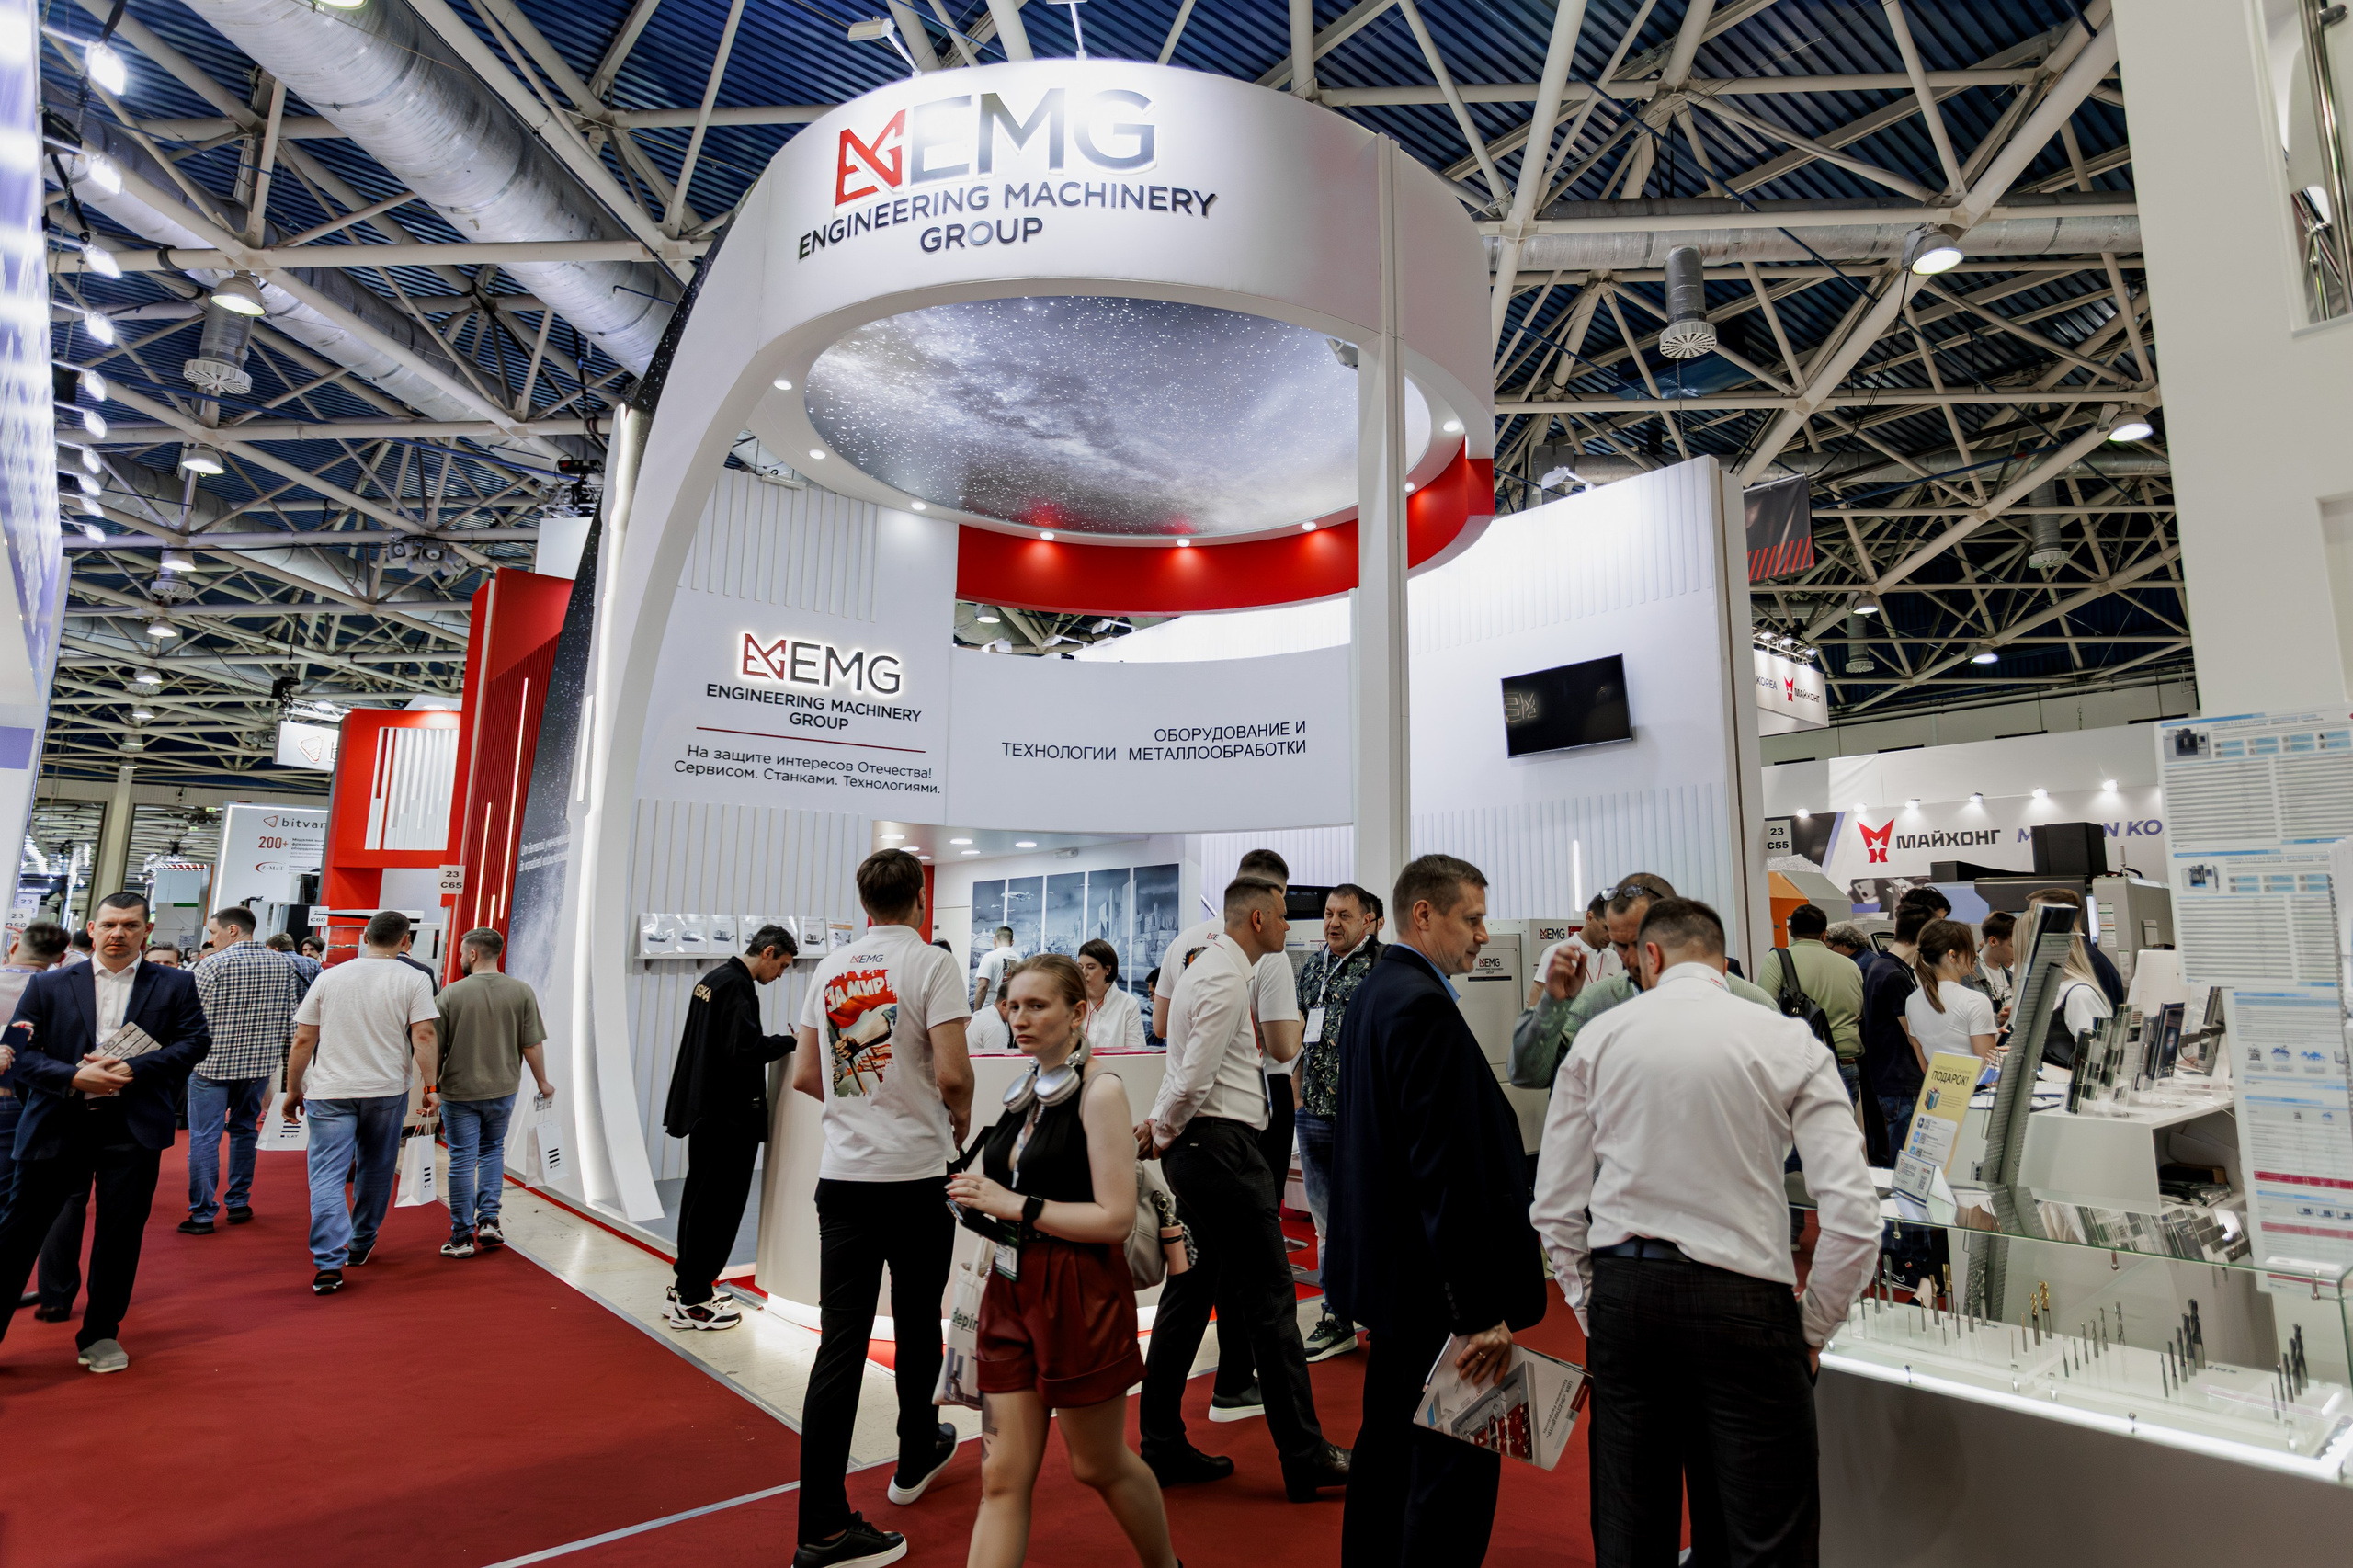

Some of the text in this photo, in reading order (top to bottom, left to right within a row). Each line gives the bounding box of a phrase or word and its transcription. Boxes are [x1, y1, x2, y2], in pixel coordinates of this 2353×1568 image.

[909, 87, 1156, 187] EMG
[799, 181, 1217, 260] ENGINEERING MACHINERY
[919, 217, 1043, 253] GROUP
[790, 641, 901, 695] EMG
[1756, 675, 1778, 690] KOREA
[706, 683, 922, 722] ENGINEERING MACHINERY
[789, 712, 849, 730] GROUP
[1154, 720, 1306, 743] ОБОРУДОВАНИЕ И
[1001, 742, 1117, 761] ТЕХНОЛОГИИ
[1128, 739, 1307, 761] МЕТАЛЛООБРАБОТКИ
[688, 744, 933, 779] На защите интересов Отечества!
[674, 760, 941, 795] Сервисом. Станками. Технологиями.
[258, 835, 289, 849] 200+
[1769, 827, 1784, 836] 23
[1896, 828, 2001, 850] МАЙХОНГ
[1767, 841, 1790, 850] C55
[1546, 928, 1565, 939] EMG
[859, 954, 883, 964] EMG
[1484, 958, 1500, 968] EMG
[825, 985, 848, 1013] ЗА
[1931, 1070, 1970, 1086] ПОДАРОК!
